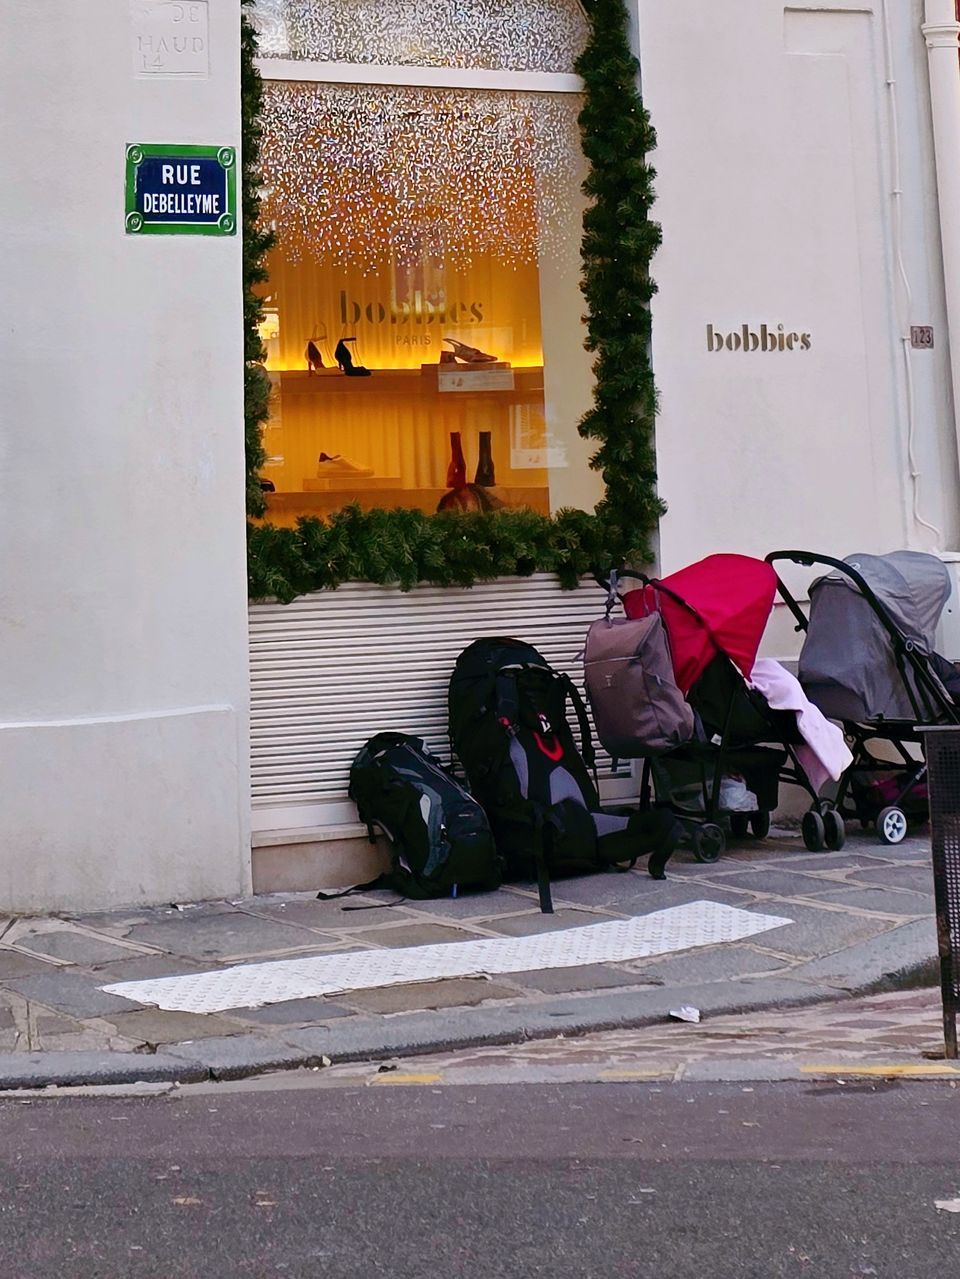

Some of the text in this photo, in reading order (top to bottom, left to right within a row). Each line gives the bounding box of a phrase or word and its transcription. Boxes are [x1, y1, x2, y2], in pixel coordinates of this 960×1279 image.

[161, 164, 201, 185] RUE
[143, 192, 220, 214] DEBELLEYME
[340, 290, 484, 325] bobbies
[396, 335, 432, 346] PARIS
[706, 323, 812, 352] bobbies
[913, 329, 932, 345] 123
